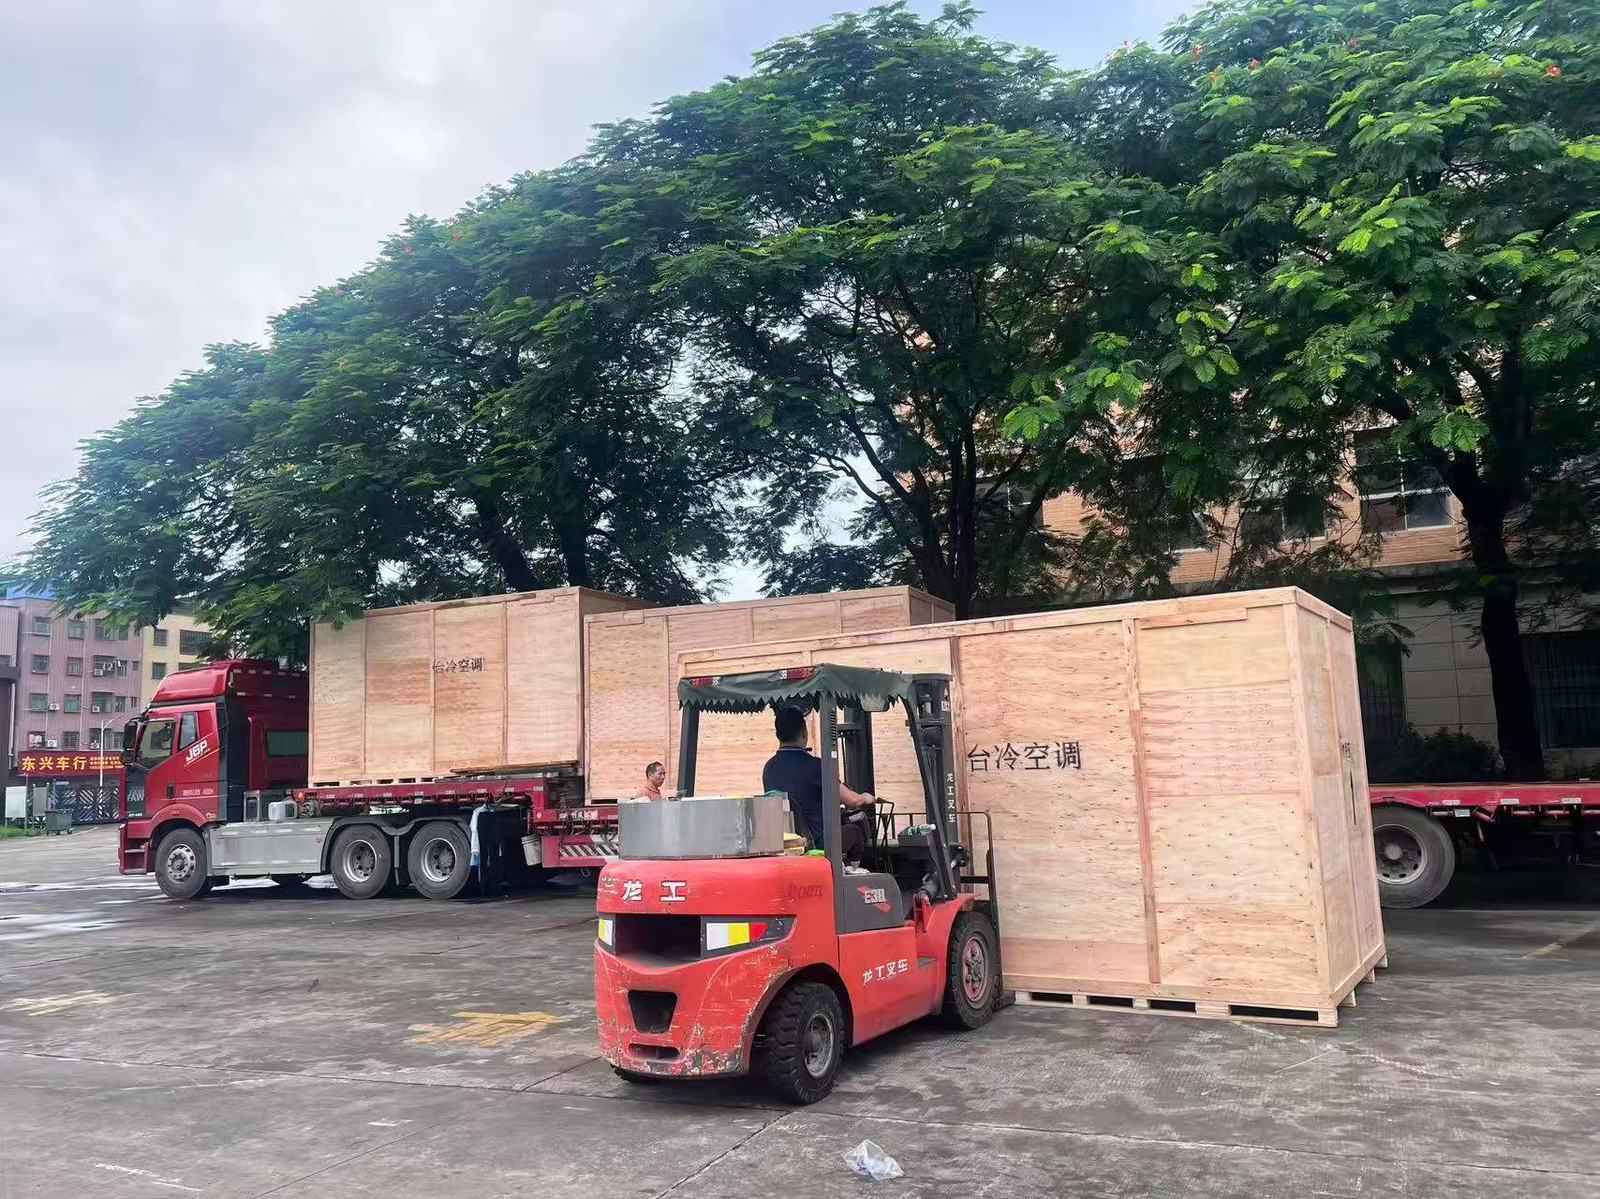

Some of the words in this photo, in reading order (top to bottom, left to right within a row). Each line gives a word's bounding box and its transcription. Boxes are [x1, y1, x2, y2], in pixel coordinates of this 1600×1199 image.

[22, 756, 86, 771] 东兴车行
[967, 741, 1081, 772] 台冷空调
[946, 773, 956, 823] 龙工叉车
[622, 880, 687, 902] 龙工
[863, 959, 908, 986] 龙工叉车
